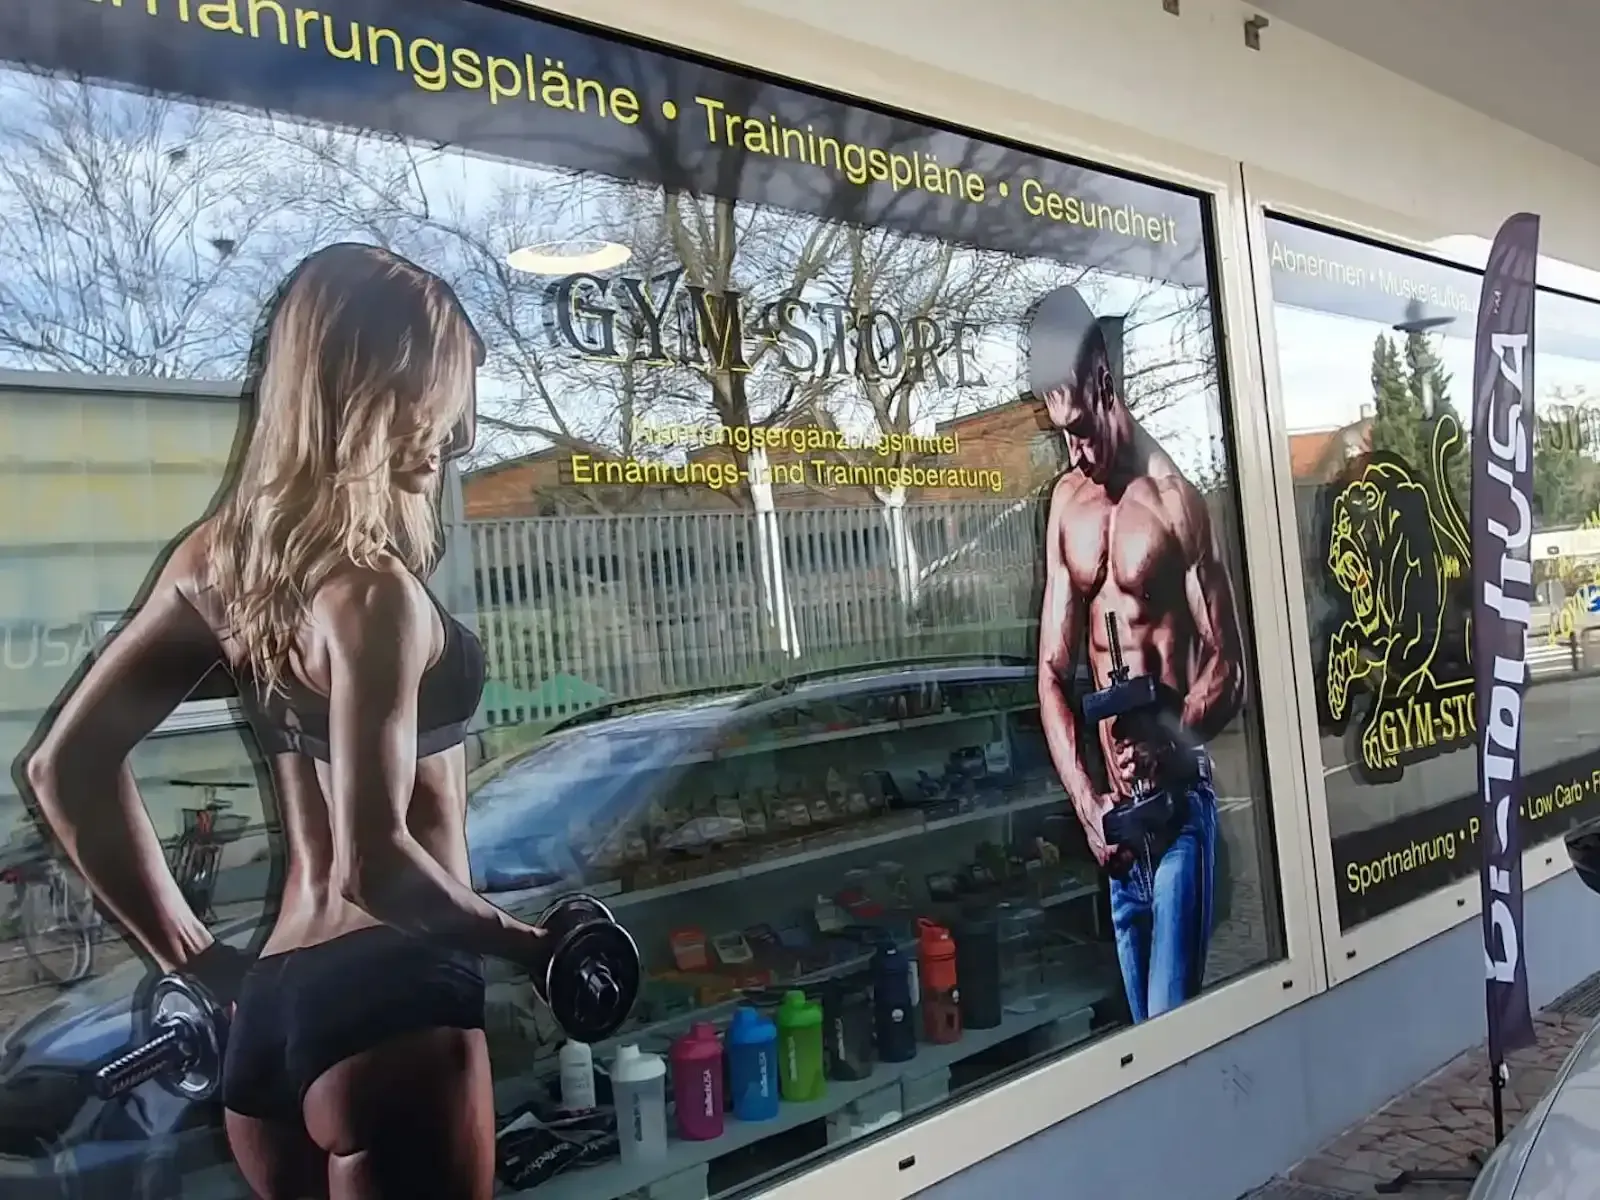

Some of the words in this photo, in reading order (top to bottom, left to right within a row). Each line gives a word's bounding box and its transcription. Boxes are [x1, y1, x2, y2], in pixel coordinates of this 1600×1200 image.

[90, 0, 639, 125] ährungspläne
[695, 96, 985, 202] Trainingspläne
[1022, 178, 1180, 246] Gesundheit
[1271, 240, 1366, 289] Abnehmen
[556, 268, 988, 389] GYM-STORE
[573, 455, 749, 490] Ernährungs-
[753, 461, 805, 485] und
[811, 460, 1002, 491] Trainingsberatung
[1347, 834, 1456, 896] Sportnahrung
[1527, 793, 1553, 820] Low
[1555, 778, 1583, 808] Carb
